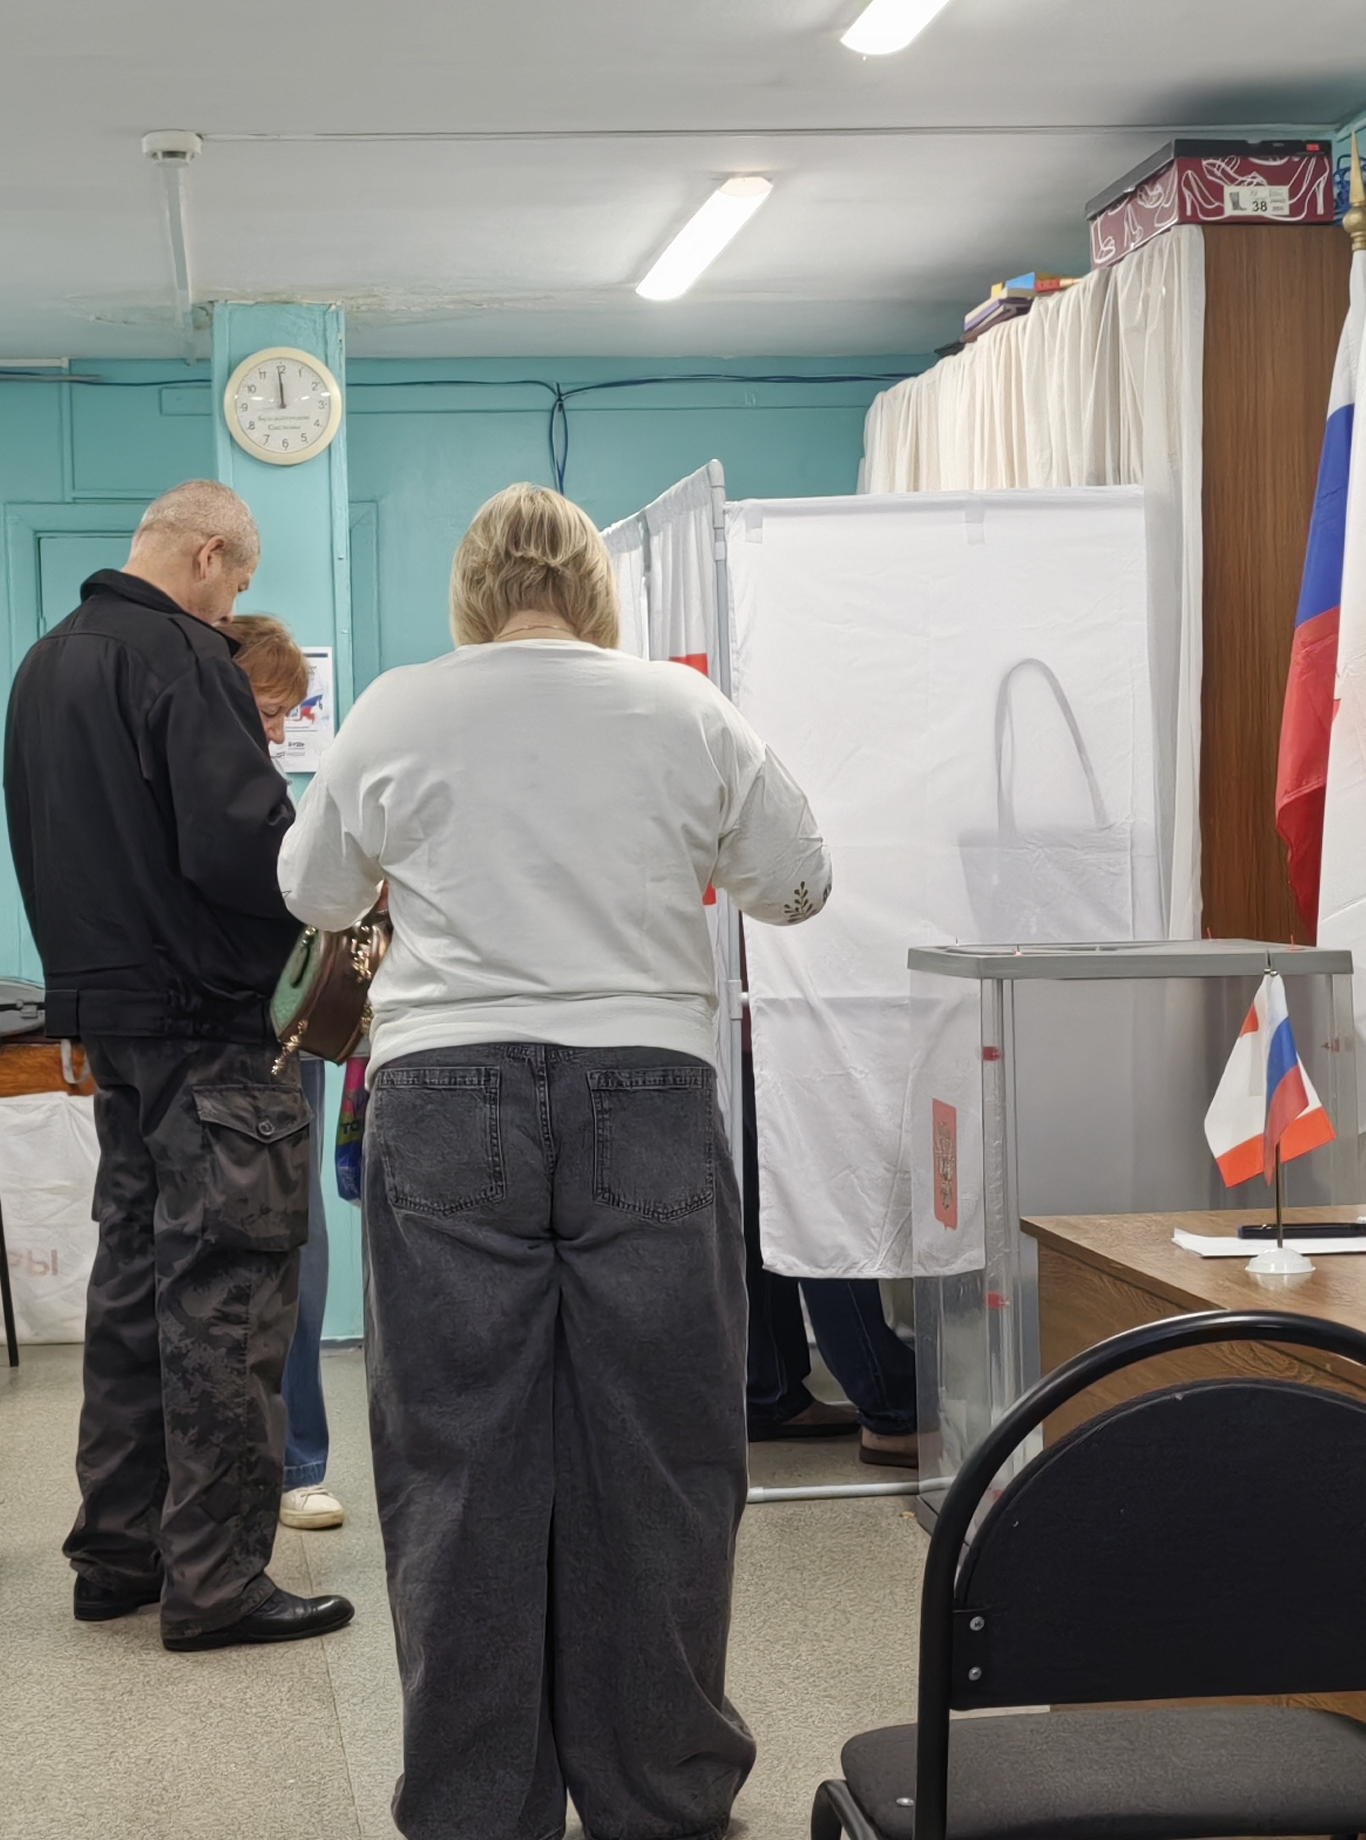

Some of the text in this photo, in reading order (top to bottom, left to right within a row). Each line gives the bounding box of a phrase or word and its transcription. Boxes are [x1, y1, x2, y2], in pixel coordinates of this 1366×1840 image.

[1252, 200, 1268, 212] 38
[258, 370, 267, 379] 11
[247, 384, 256, 393] 10
[312, 381, 319, 391] 2
[241, 403, 248, 412] 9
[318, 401, 325, 409] 3
[248, 421, 255, 430] 8
[314, 419, 320, 427] 4
[263, 434, 270, 445] 7
[300, 433, 308, 442] 5
[282, 439, 289, 449] 6
